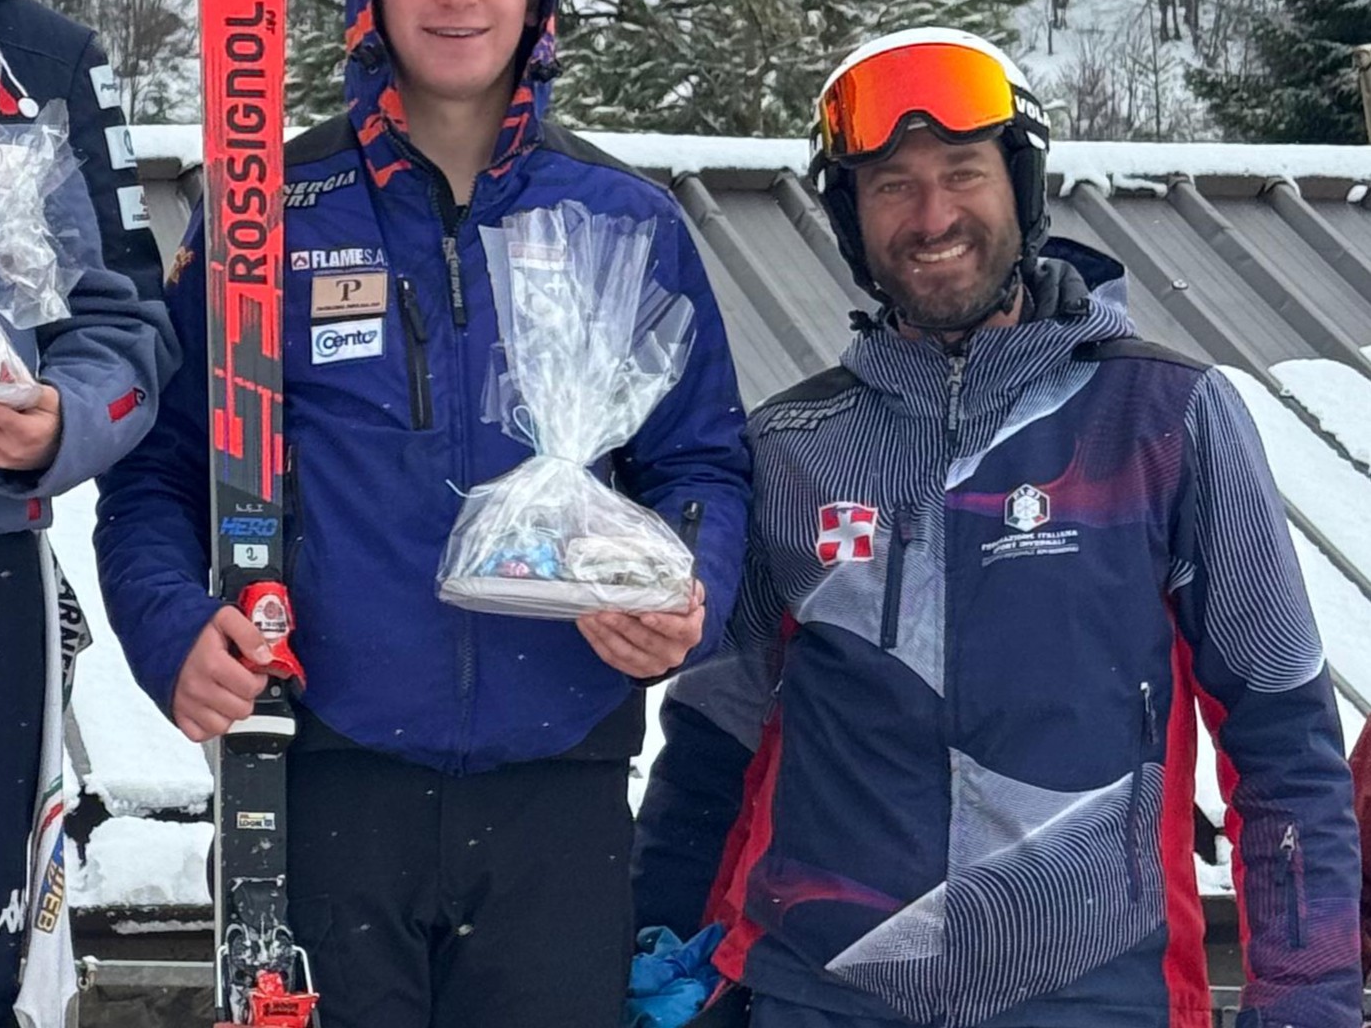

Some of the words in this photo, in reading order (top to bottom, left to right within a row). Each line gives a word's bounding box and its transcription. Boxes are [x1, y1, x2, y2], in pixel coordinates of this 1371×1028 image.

[225, 1, 268, 284] ROSSIGNOL
[335, 279, 362, 302] P
[220, 517, 279, 537] HERO
